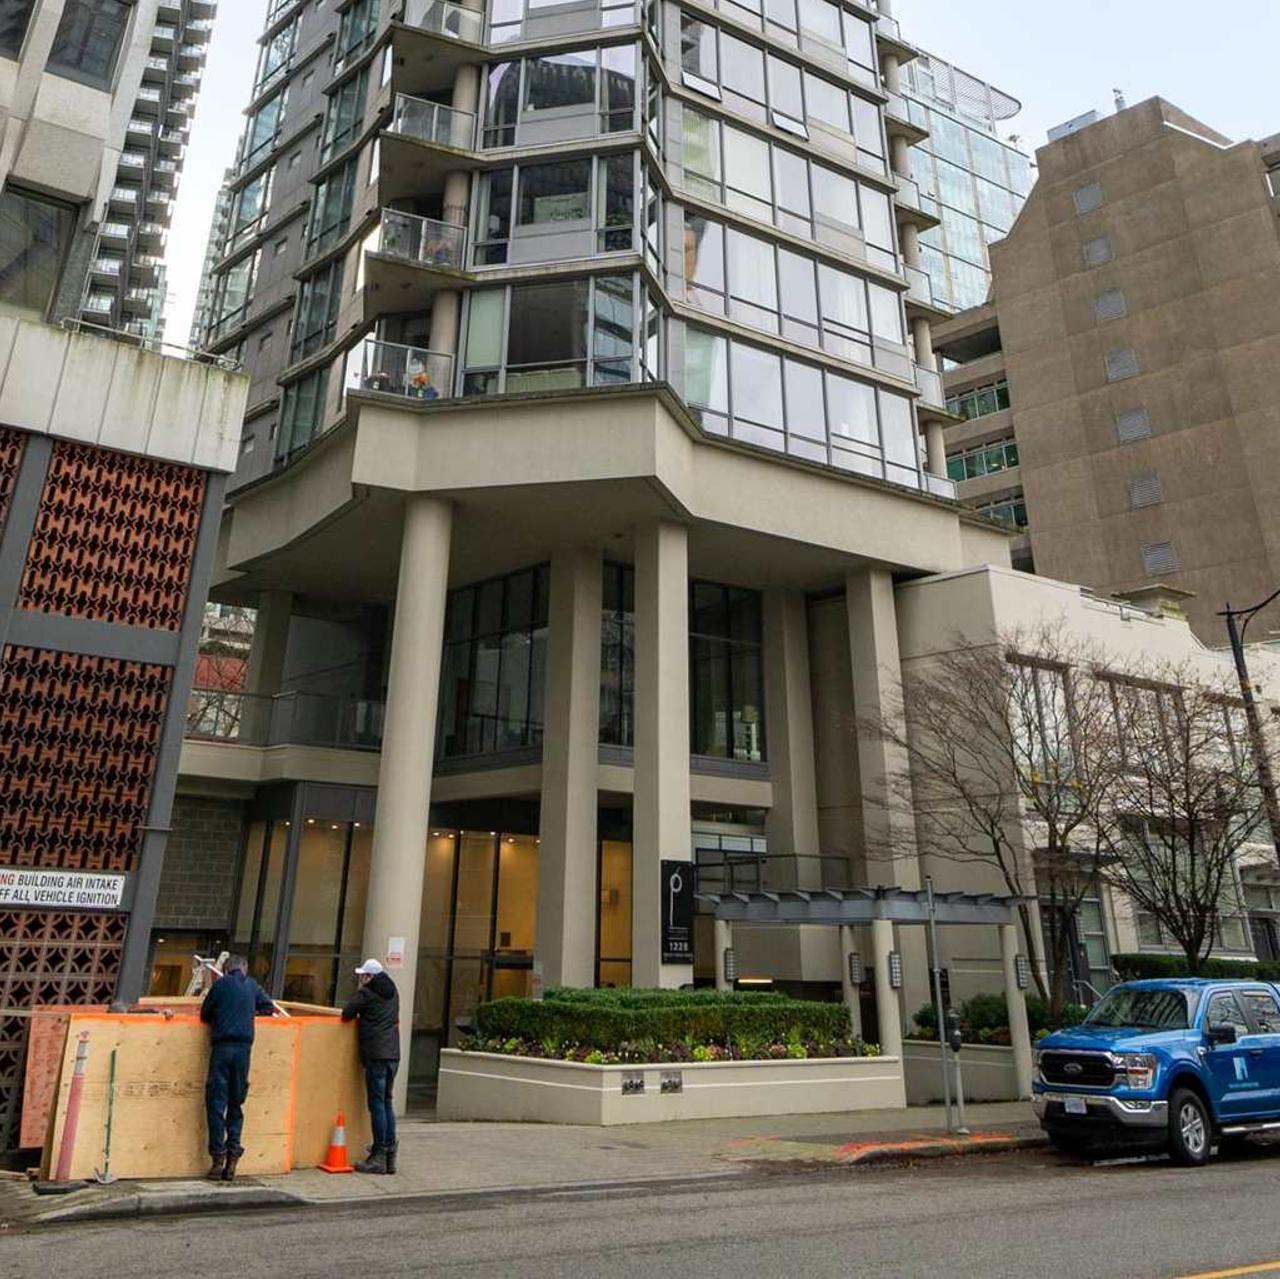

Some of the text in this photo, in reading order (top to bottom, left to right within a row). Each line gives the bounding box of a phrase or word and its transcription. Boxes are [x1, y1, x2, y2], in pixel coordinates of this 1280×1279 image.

[17, 874, 64, 889] BUILDING
[66, 877, 83, 889] AIR
[85, 879, 118, 890] INTAKE
[12, 889, 30, 902] ALL
[34, 890, 73, 903] VEHICLE
[76, 892, 118, 904] IGNITION
